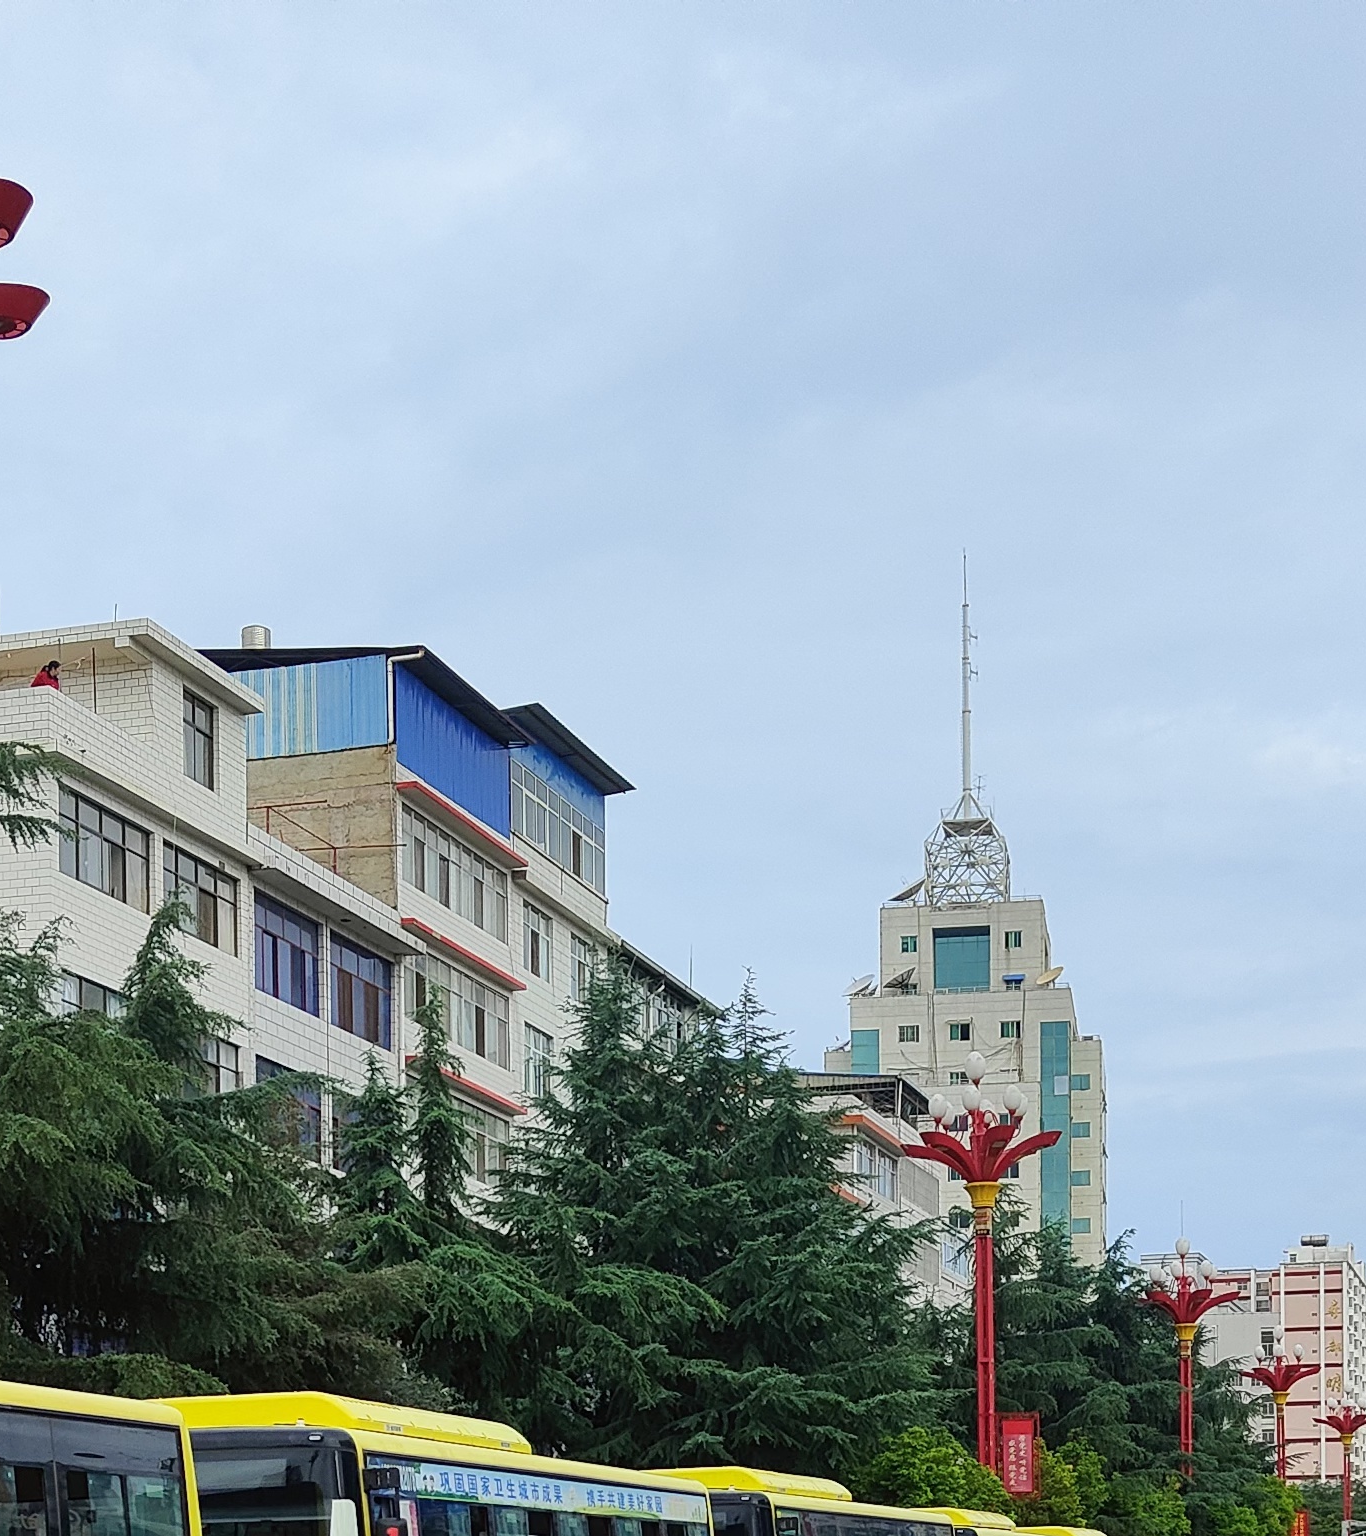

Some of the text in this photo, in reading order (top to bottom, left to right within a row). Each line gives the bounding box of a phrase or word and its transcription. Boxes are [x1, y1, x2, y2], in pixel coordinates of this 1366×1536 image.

[440, 1472, 564, 1504] 巩固国家卫生城市成果
[586, 1488, 663, 1513] 携手共建美好家园
